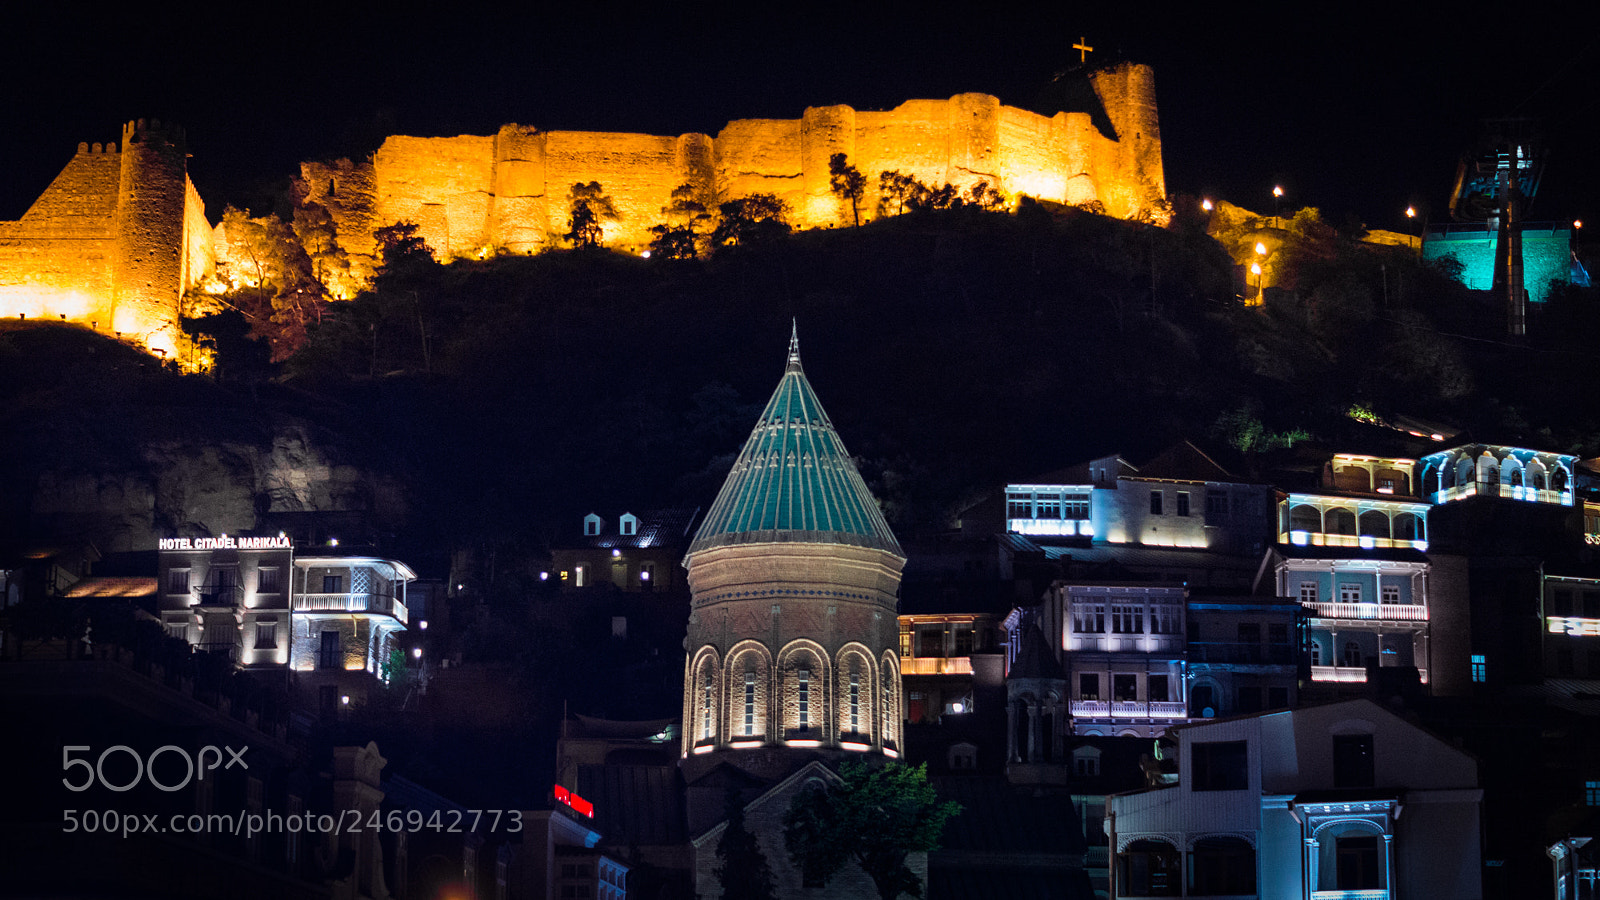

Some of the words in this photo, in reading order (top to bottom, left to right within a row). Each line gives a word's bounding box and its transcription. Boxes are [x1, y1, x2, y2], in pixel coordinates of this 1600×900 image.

[159, 538, 193, 549] HOTEL
[194, 538, 237, 549] CITADEL
[238, 537, 290, 548] NARIKALA
